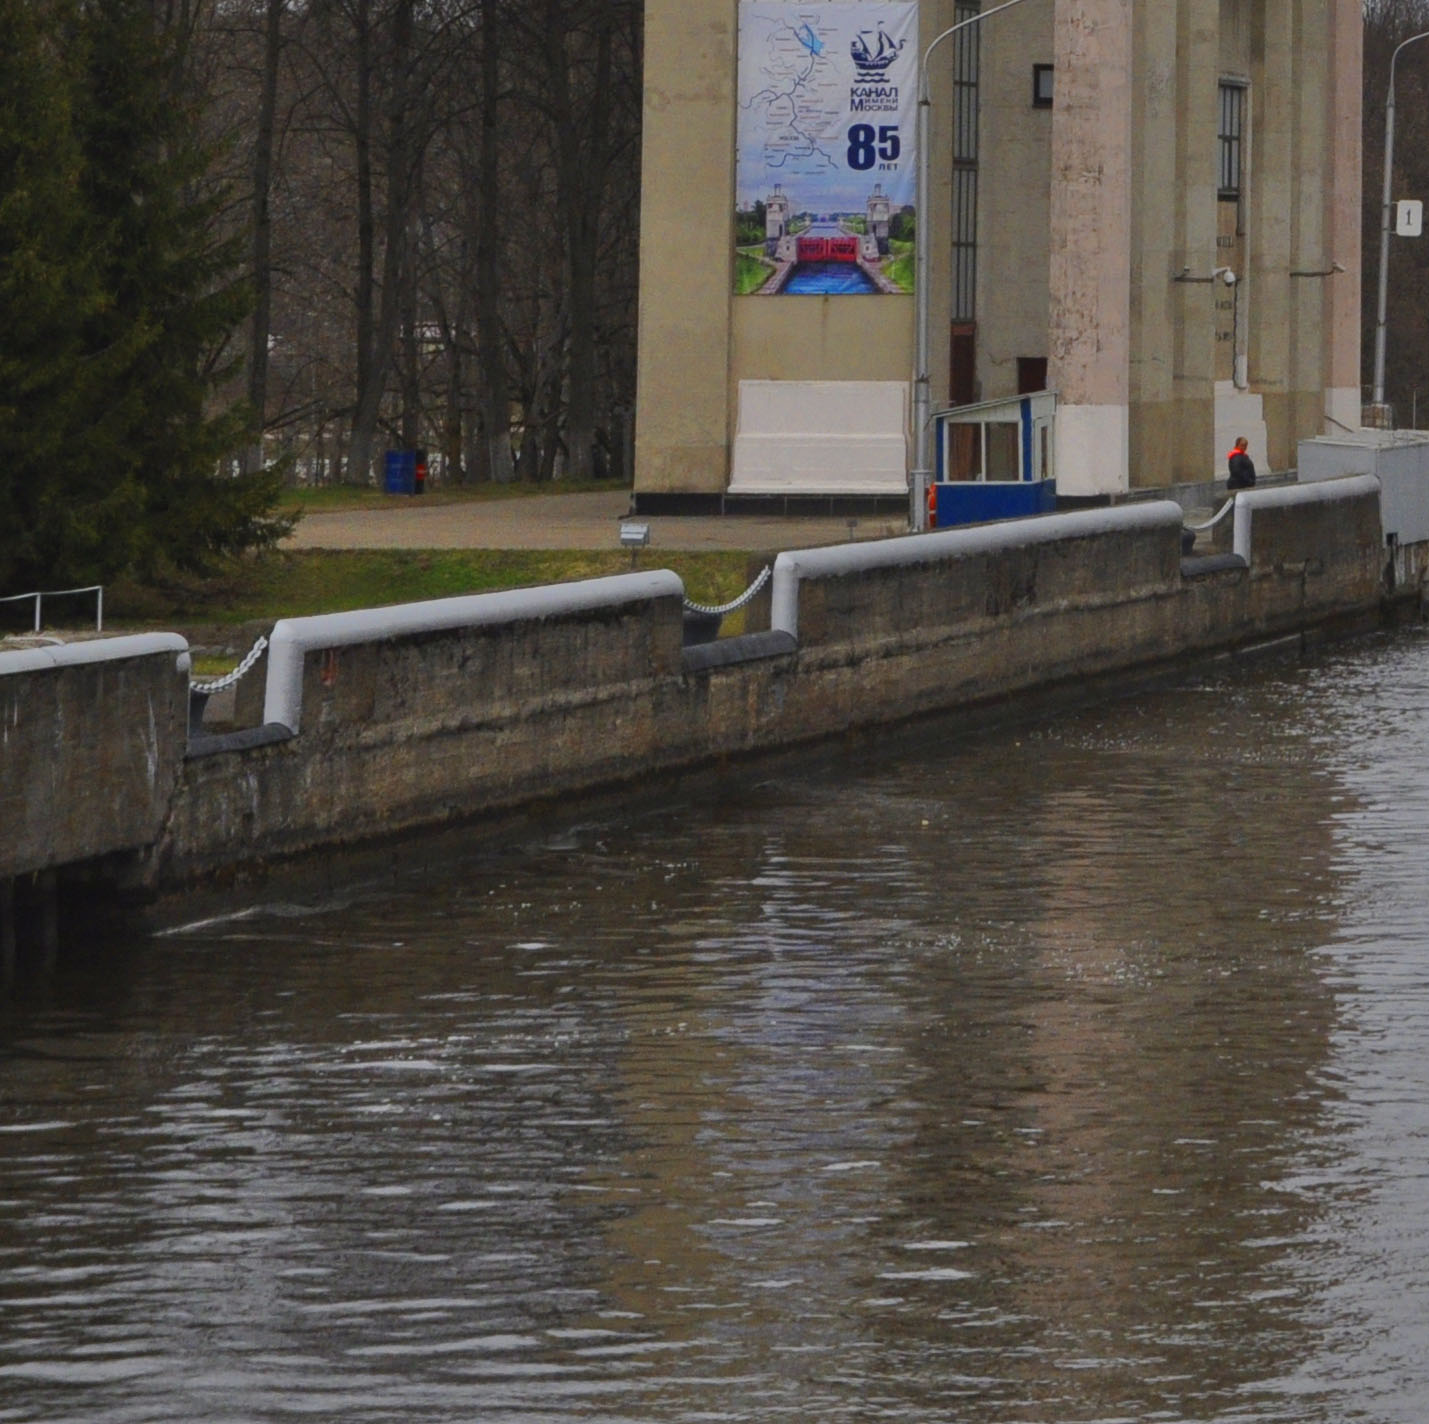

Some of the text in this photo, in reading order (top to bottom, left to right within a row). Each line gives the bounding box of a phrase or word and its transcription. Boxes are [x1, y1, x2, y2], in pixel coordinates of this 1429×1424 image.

[850, 87, 899, 98] КАНАЛ
[847, 123, 901, 171] 85
[878, 162, 899, 172] ЛЕТ
[1405, 207, 1413, 226] 1
